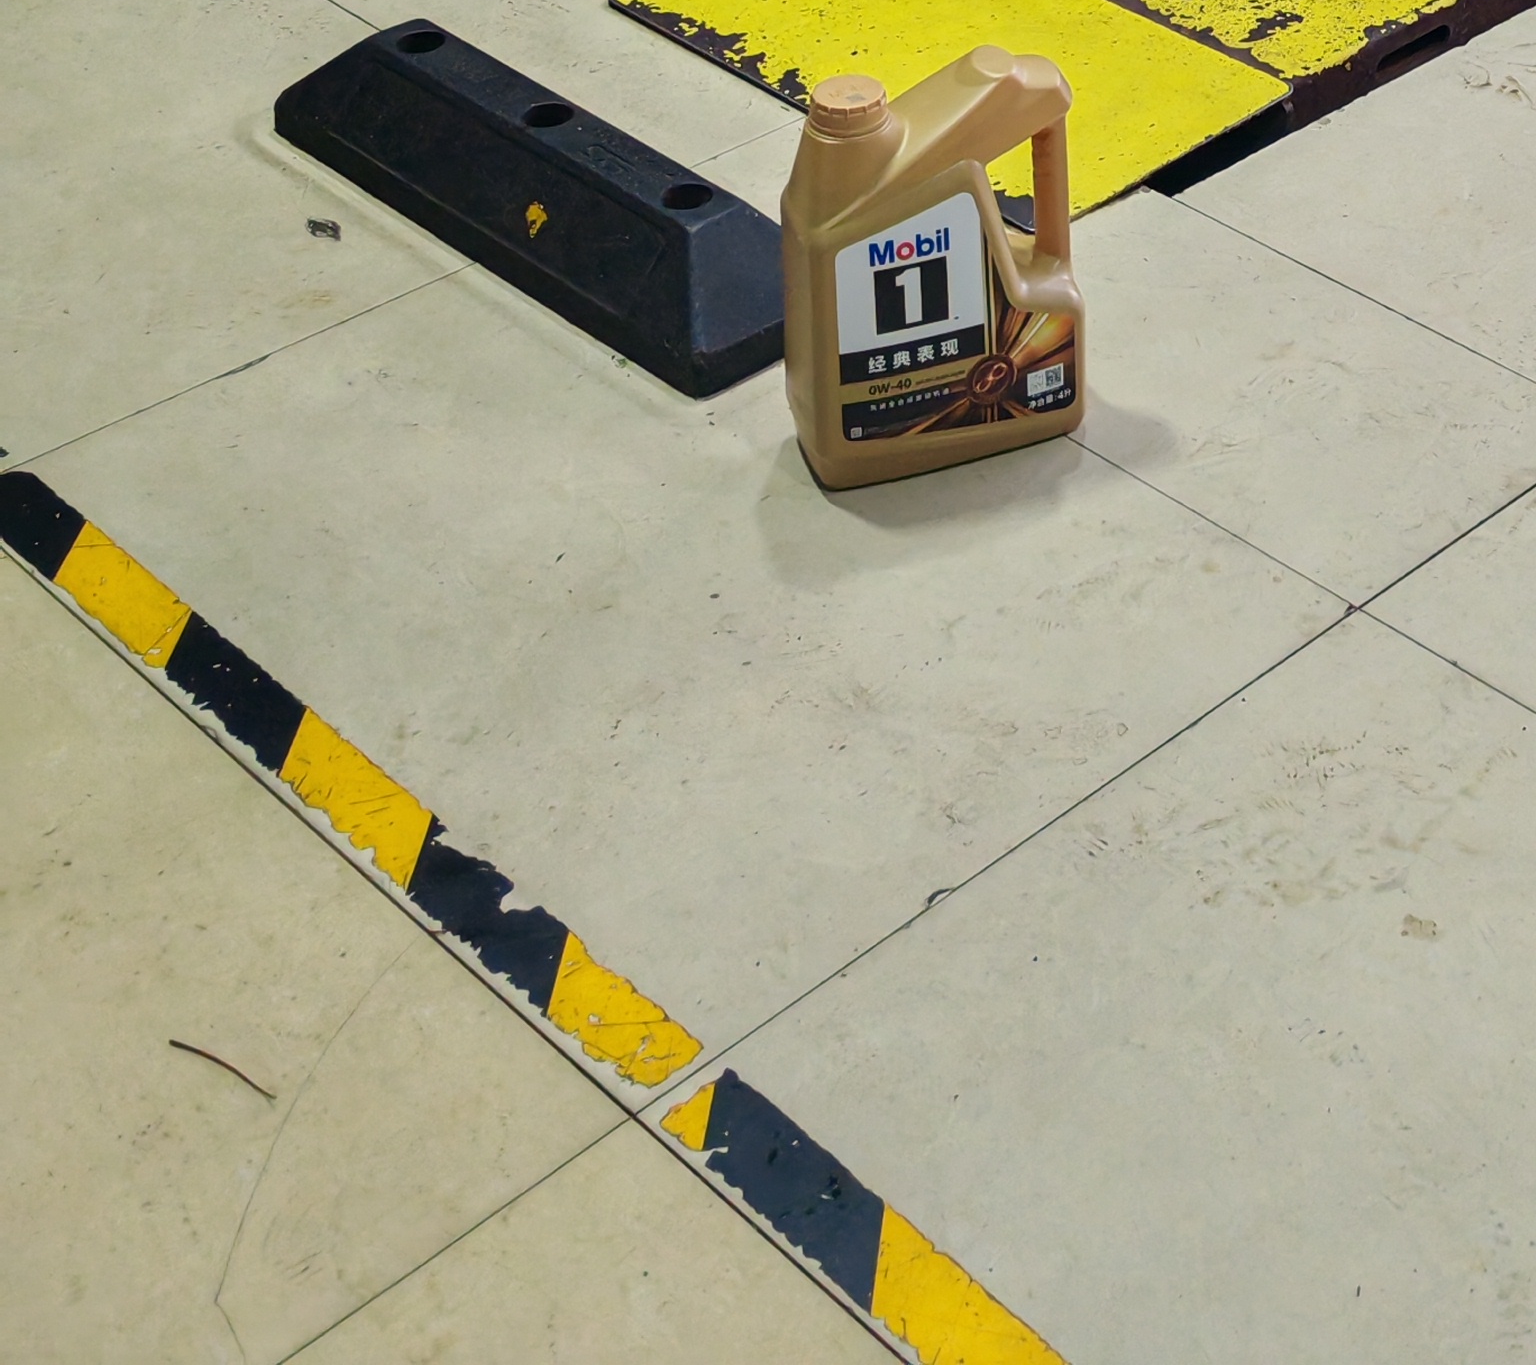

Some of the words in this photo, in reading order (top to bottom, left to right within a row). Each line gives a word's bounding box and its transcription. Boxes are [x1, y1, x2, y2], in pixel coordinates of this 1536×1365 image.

[868, 227, 950, 267] Mobil
[868, 338, 960, 375] 经典表现
[868, 378, 912, 396] 0W-40
